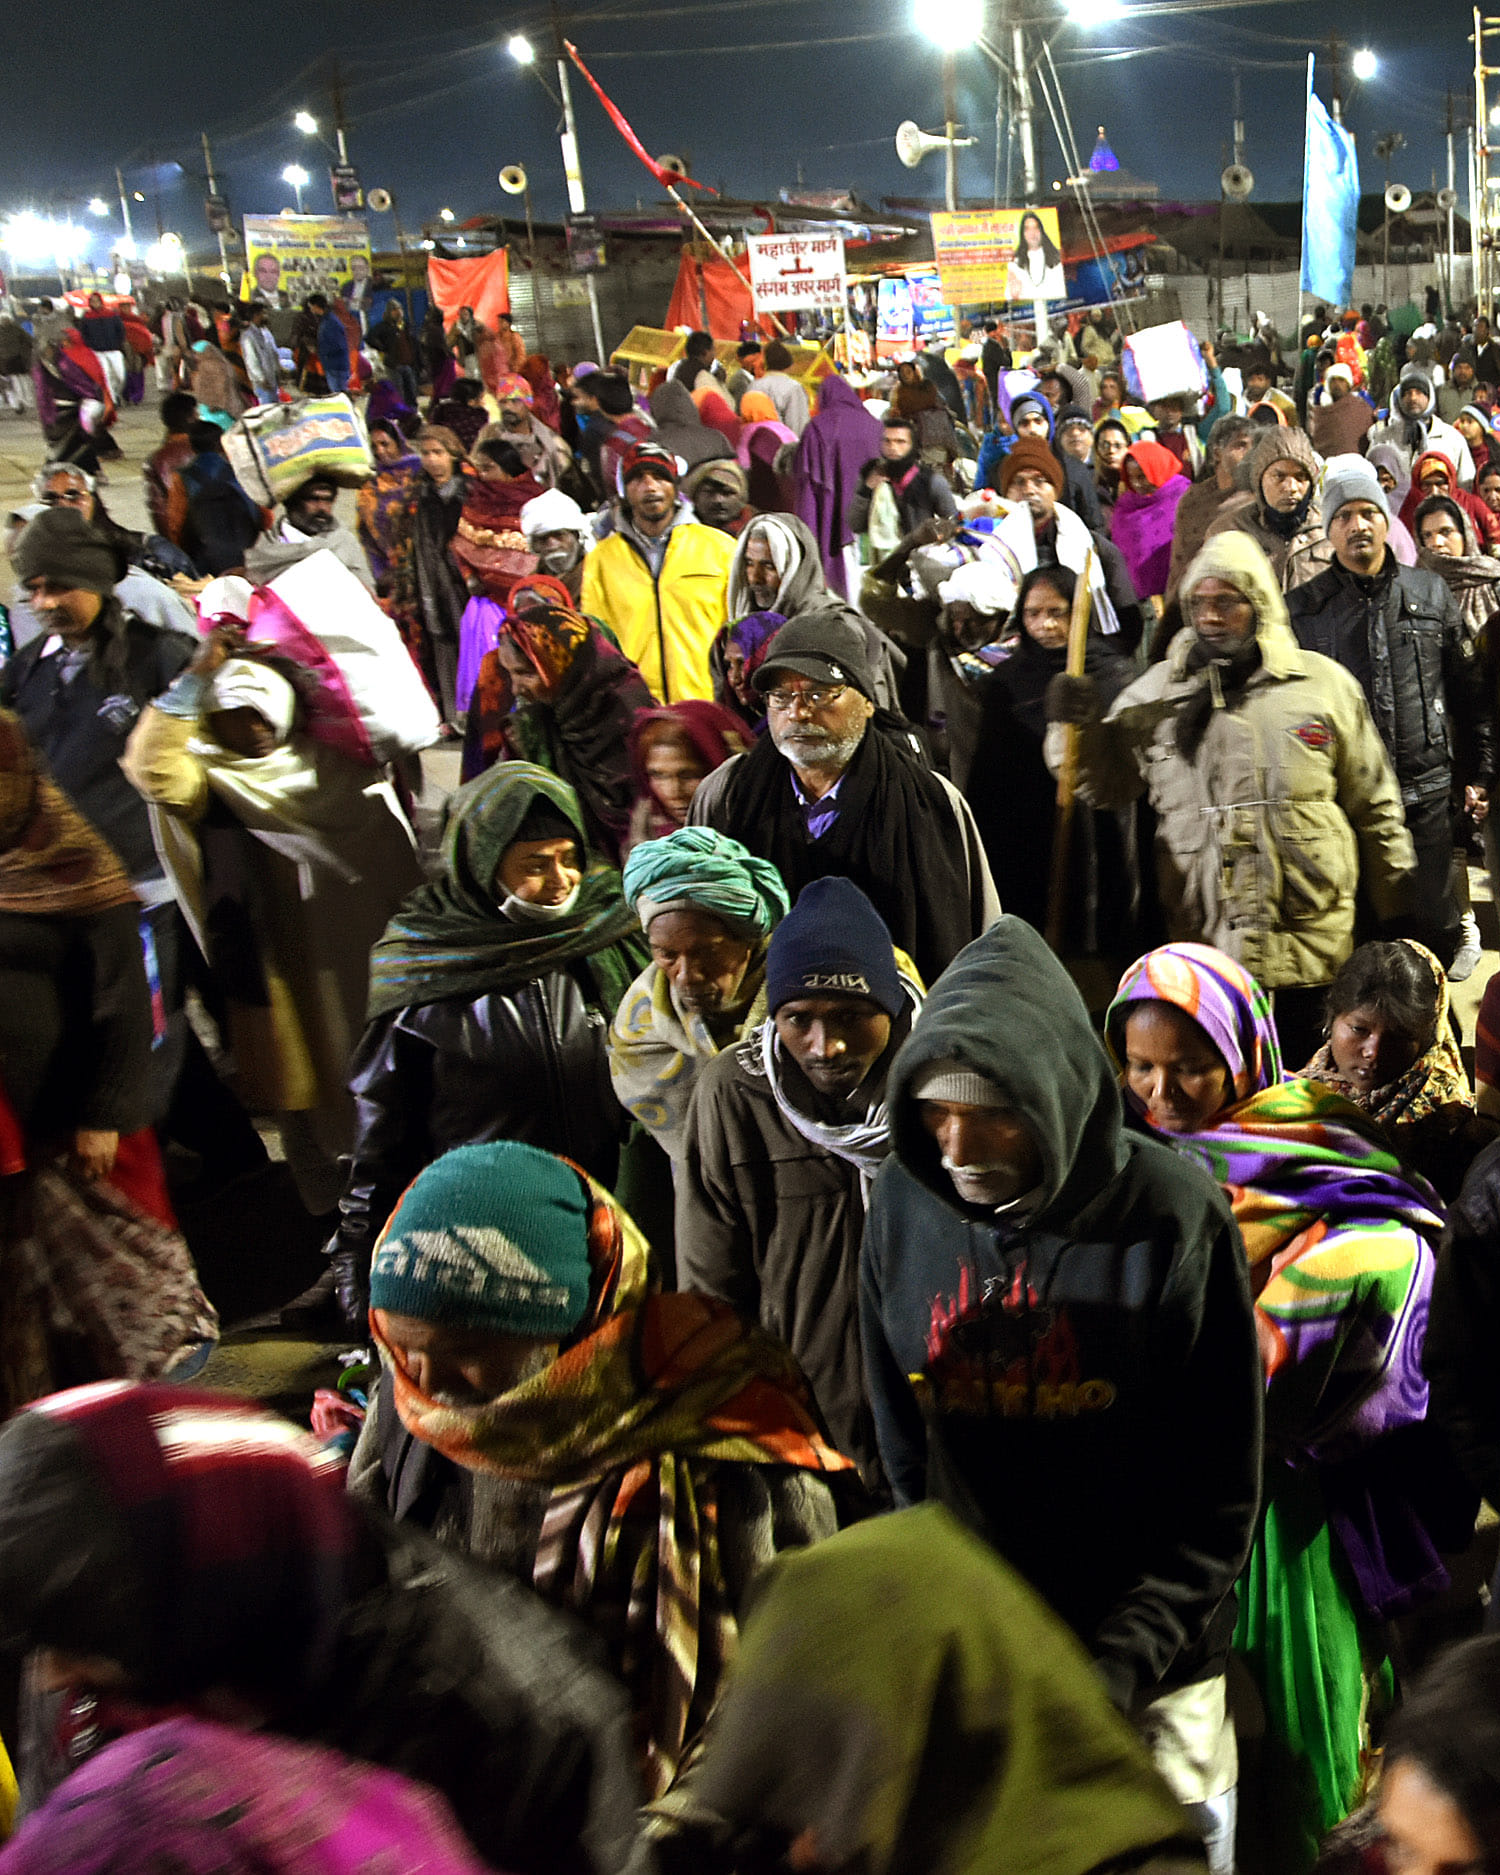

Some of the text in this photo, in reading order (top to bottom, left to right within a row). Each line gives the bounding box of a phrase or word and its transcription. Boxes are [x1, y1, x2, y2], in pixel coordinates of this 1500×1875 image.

[756, 234, 837, 260] महावीर मार्ग
[756, 278, 788, 299] संगम
[818, 272, 841, 293] मार्ग
